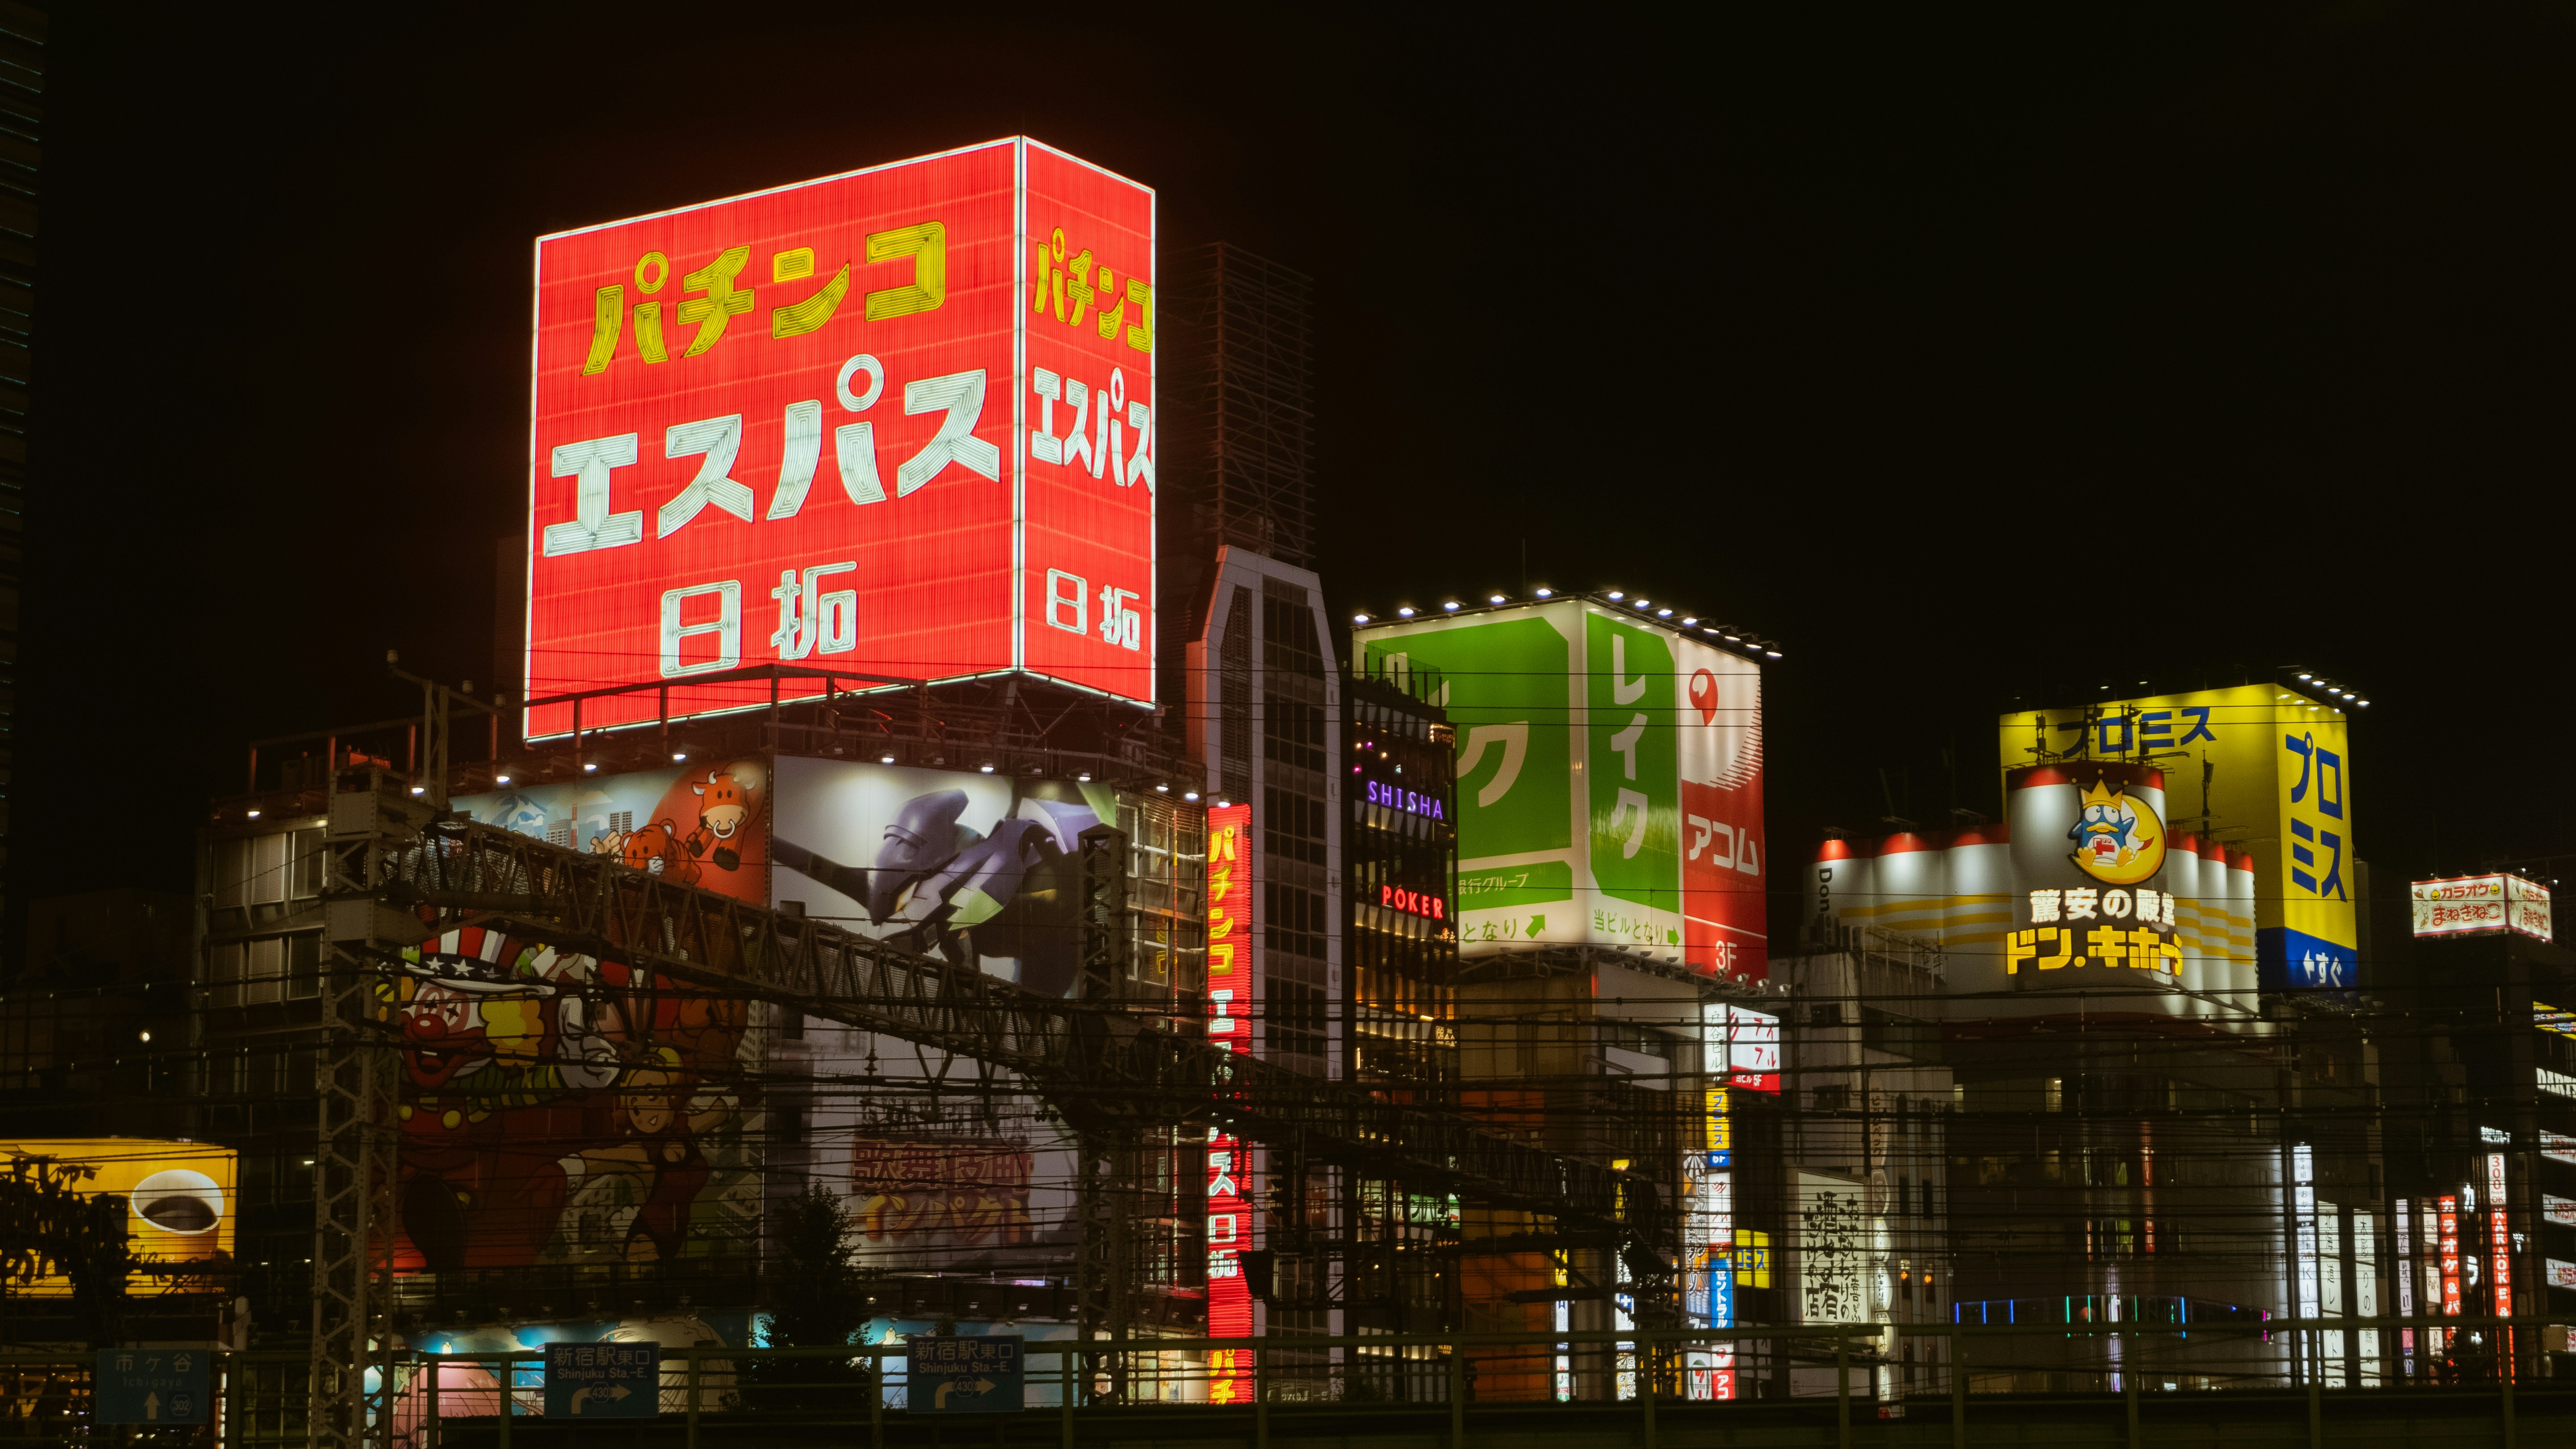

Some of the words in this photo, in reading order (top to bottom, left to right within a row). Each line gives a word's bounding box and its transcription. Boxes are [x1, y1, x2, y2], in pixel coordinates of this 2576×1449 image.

[581, 220, 946, 377] パチンコ
[1033, 227, 1153, 353] パチンコ
[1031, 366, 1154, 497] エスパス
[542, 353, 1001, 557] エスパス
[1611, 633, 1647, 860] レイク
[2056, 706, 2218, 758] プロミス
[1367, 779, 1444, 820] SHISHA
[1688, 813, 1759, 876] アコム
[1208, 824, 1236, 976] パチンコ
[1449, 872, 1529, 896] 銀行グループ
[2440, 882, 2491, 900] カラオケ
[2526, 889, 2545, 906] カラオケ
[1382, 885, 1444, 919] POKER
[2029, 886, 2175, 927] 驚安の殿堂
[2431, 901, 2502, 928] まねきねこ
[2523, 905, 2548, 932] まねきねこ
[1463, 918, 1517, 943] となり
[1594, 909, 1663, 944] 当ビルとなり
[1715, 940, 1737, 970] 3F
[2315, 952, 2342, 988] すぐ
[853, 1138, 1034, 1195] 歌舞伎町
[2492, 1156, 2501, 1190] 300
[1715, 1269, 1728, 1329] セントラル
[553, 1346, 650, 1366] 新宿駅東口
[915, 1340, 1014, 1361] 新宿駅東口
[124, 1376, 182, 1389] Ichigaya
[558, 1368, 605, 1381] Shinjuku
[919, 1362, 967, 1375] Shinjuku
[592, 1387, 609, 1398] 430
[956, 1381, 973, 1392] 430
[173, 1400, 190, 1411] 302
